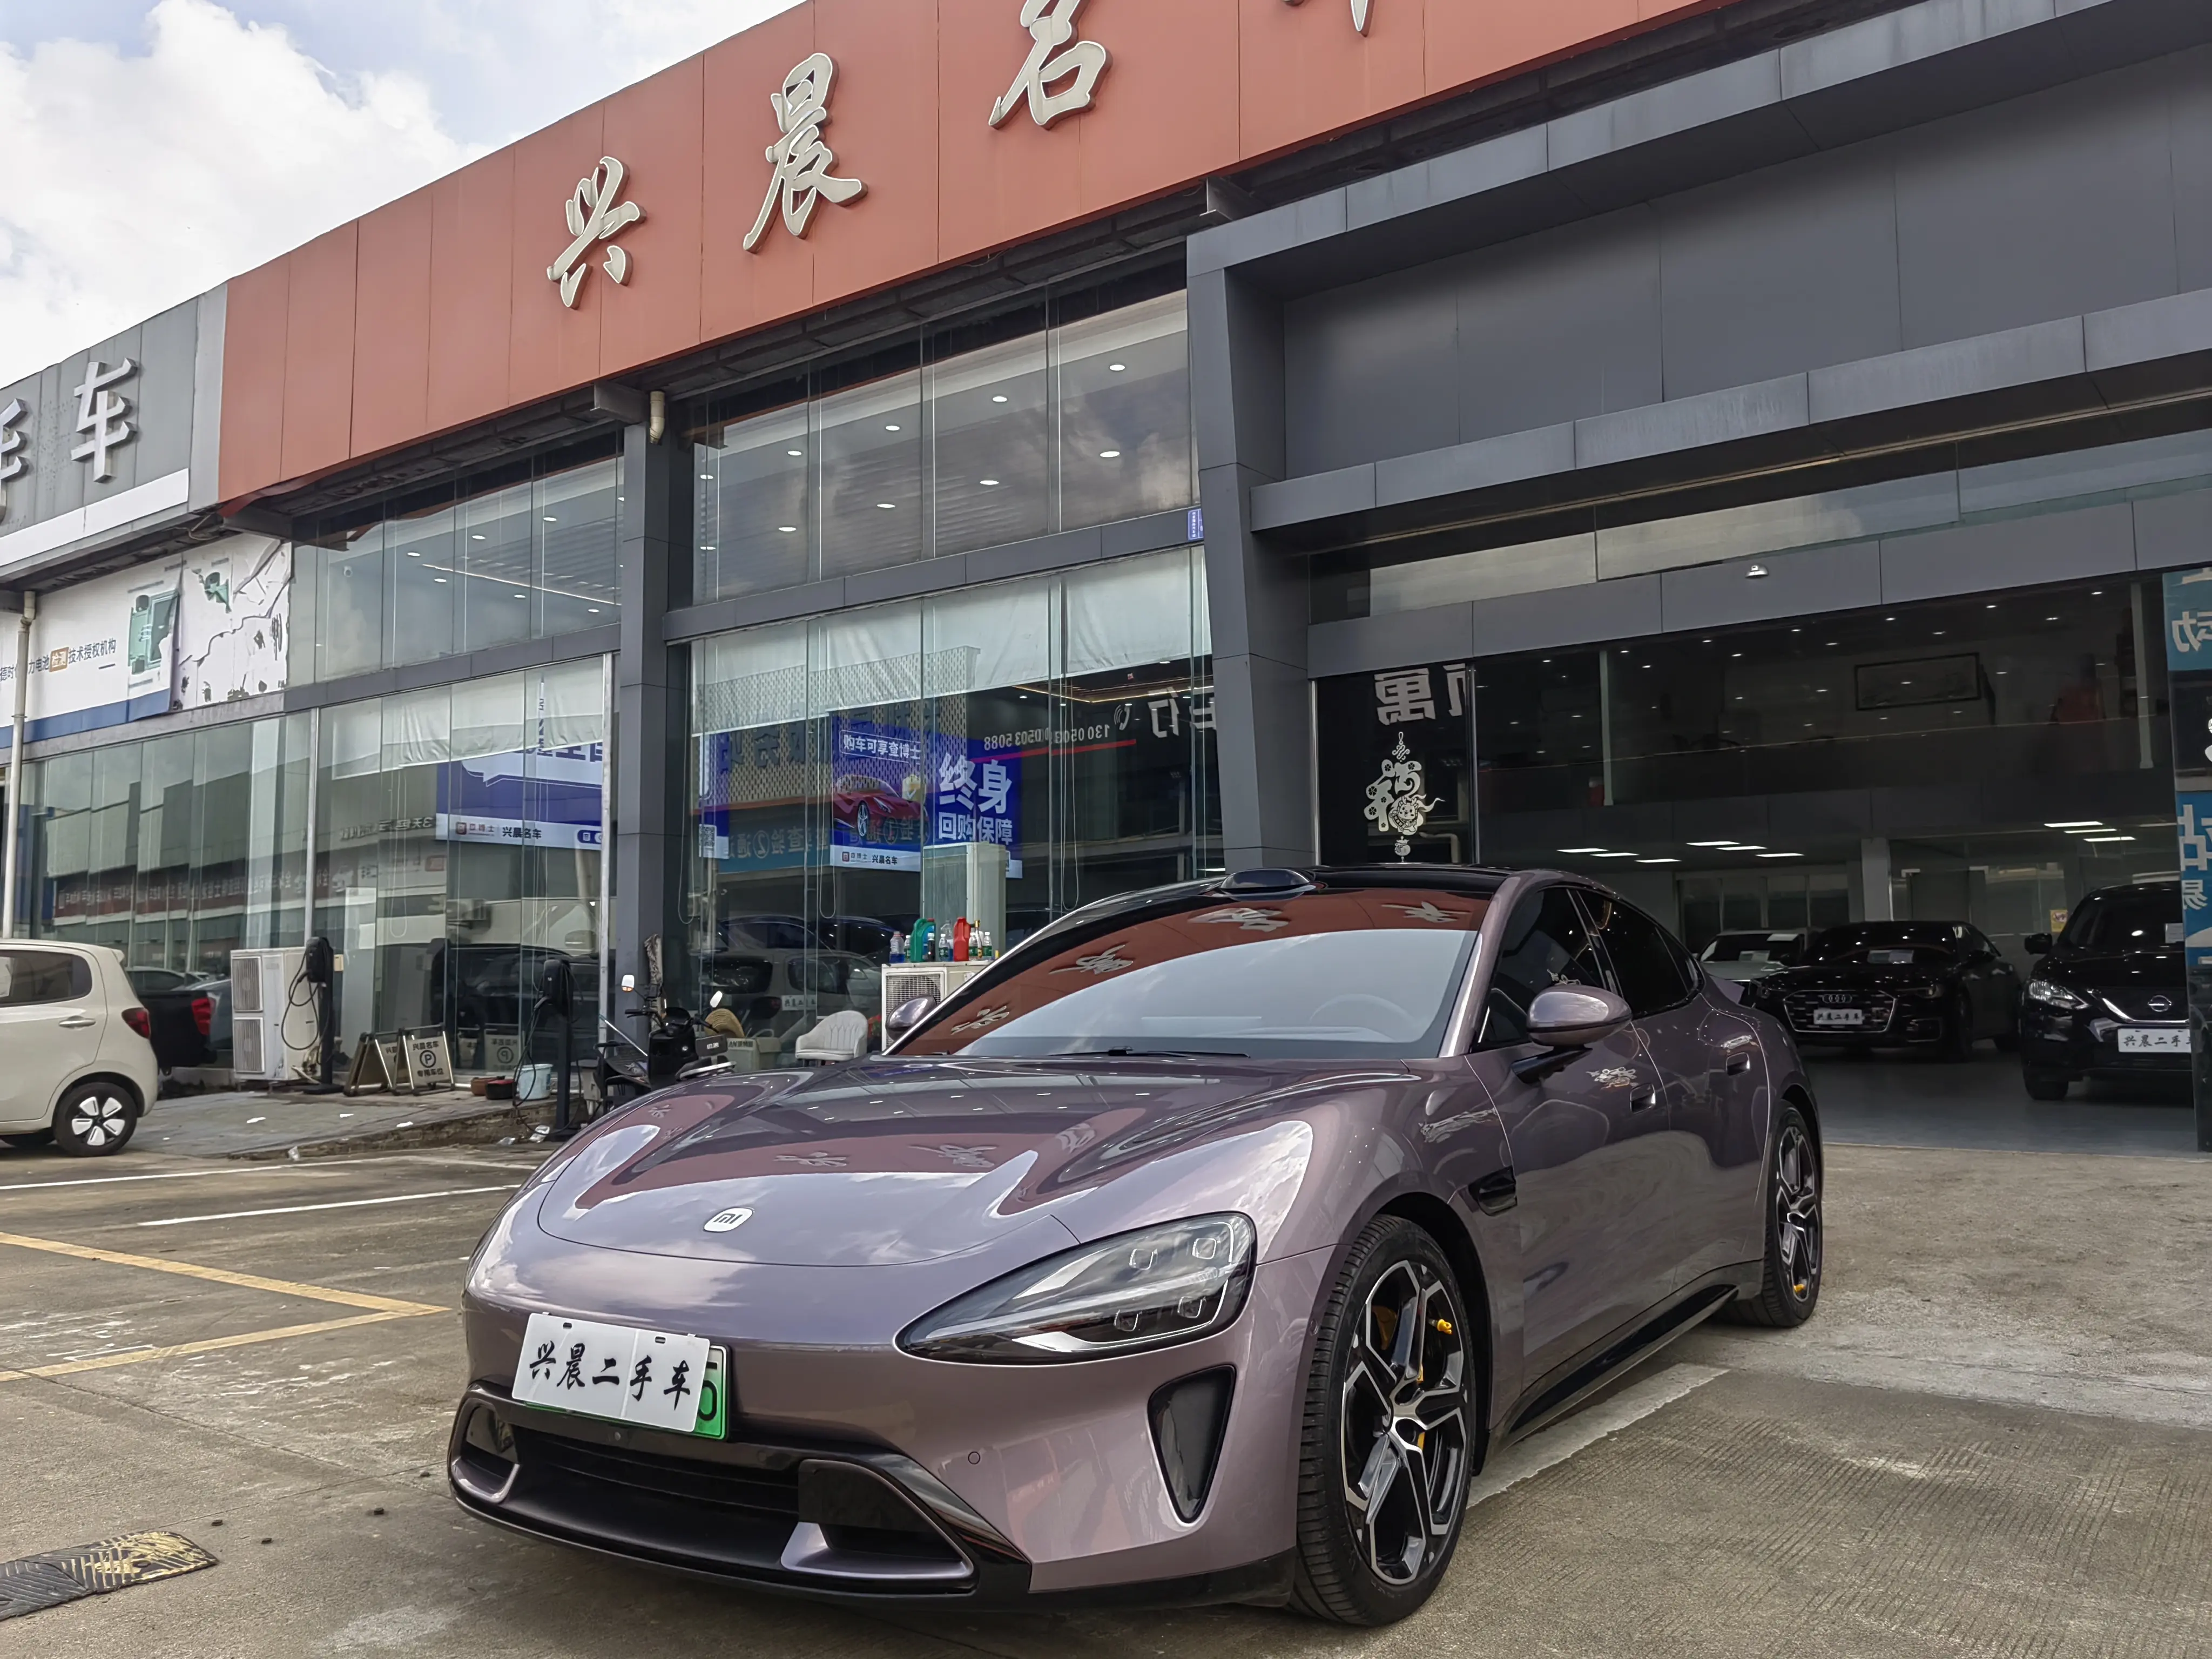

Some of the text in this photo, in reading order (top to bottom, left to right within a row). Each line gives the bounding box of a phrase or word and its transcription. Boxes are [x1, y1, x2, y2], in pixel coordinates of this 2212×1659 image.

[547, 0, 1373, 310] 兴晨名
[69, 637, 117, 664] 技术授权机构
[843, 734, 921, 760] 购车可享查博士
[939, 752, 1013, 814] 终身
[502, 826, 542, 839] 兴晨名车
[938, 811, 1013, 845] 回购保障
[872, 854, 898, 865] 兴晨名车
[529, 1340, 691, 1411] 兴晨二手车
